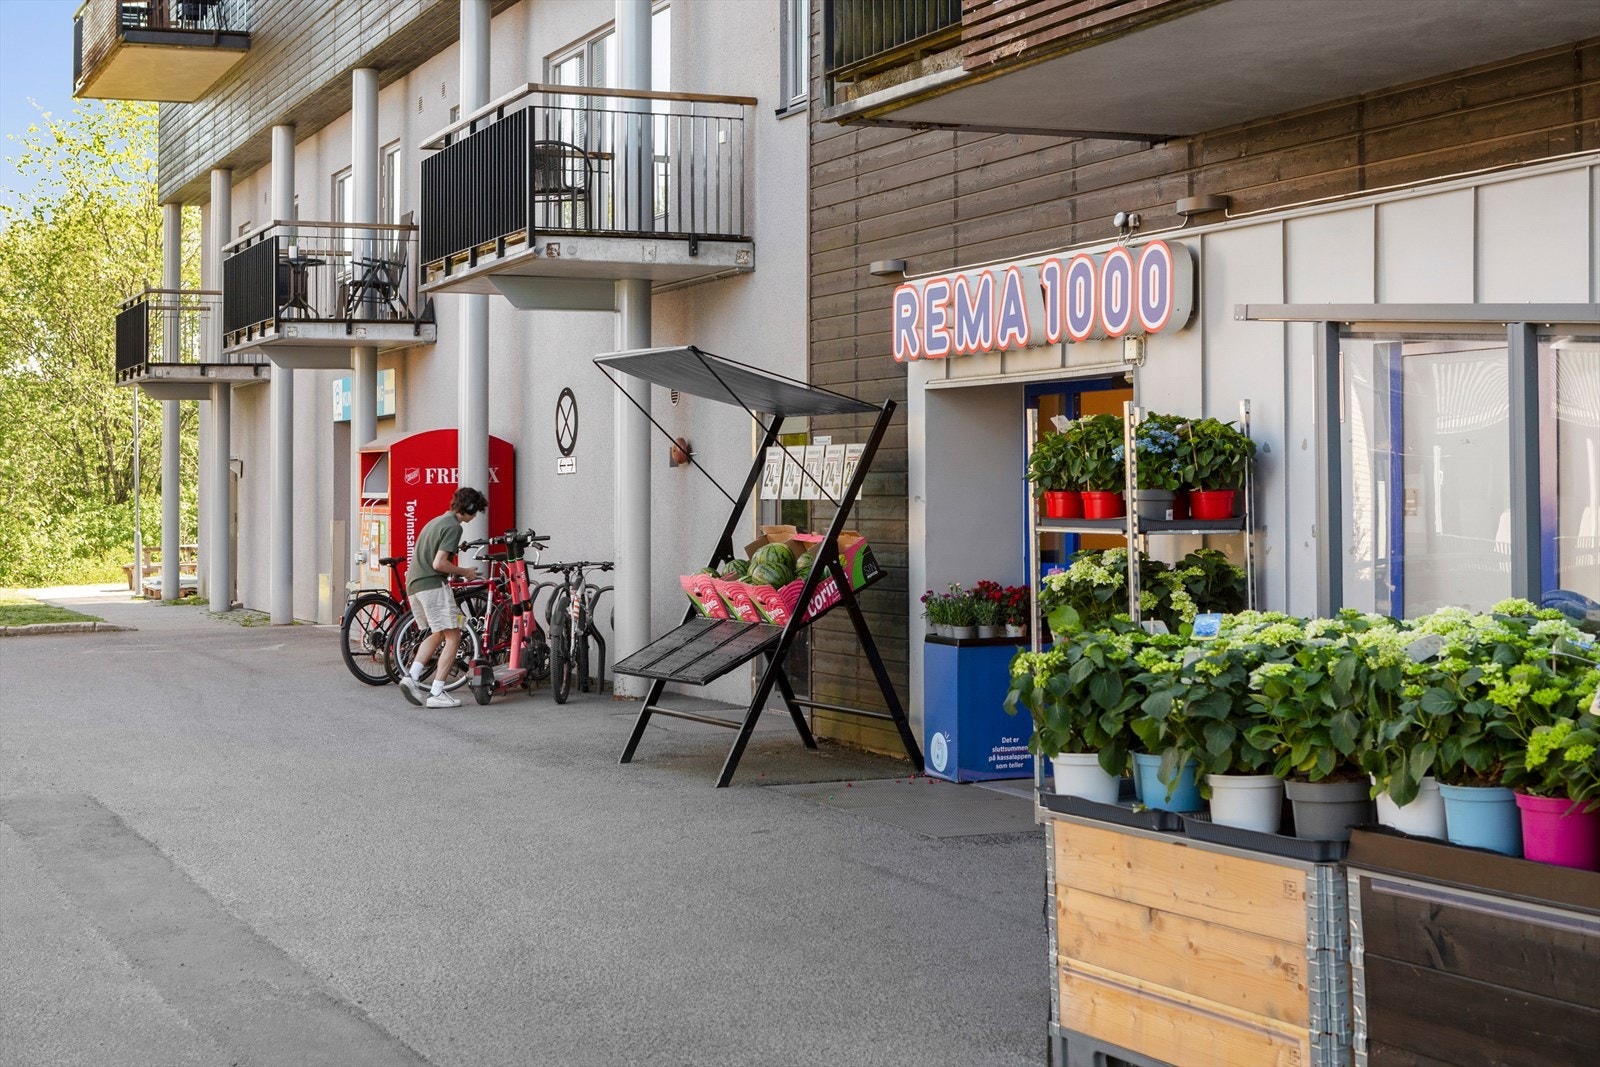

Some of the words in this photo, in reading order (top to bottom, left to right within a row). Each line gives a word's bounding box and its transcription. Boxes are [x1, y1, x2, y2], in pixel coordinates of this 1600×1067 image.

[892, 265, 1030, 363] REMA
[1041, 239, 1174, 345] 1000
[425, 467, 500, 484] FREX
[988, 754, 996, 762] på
